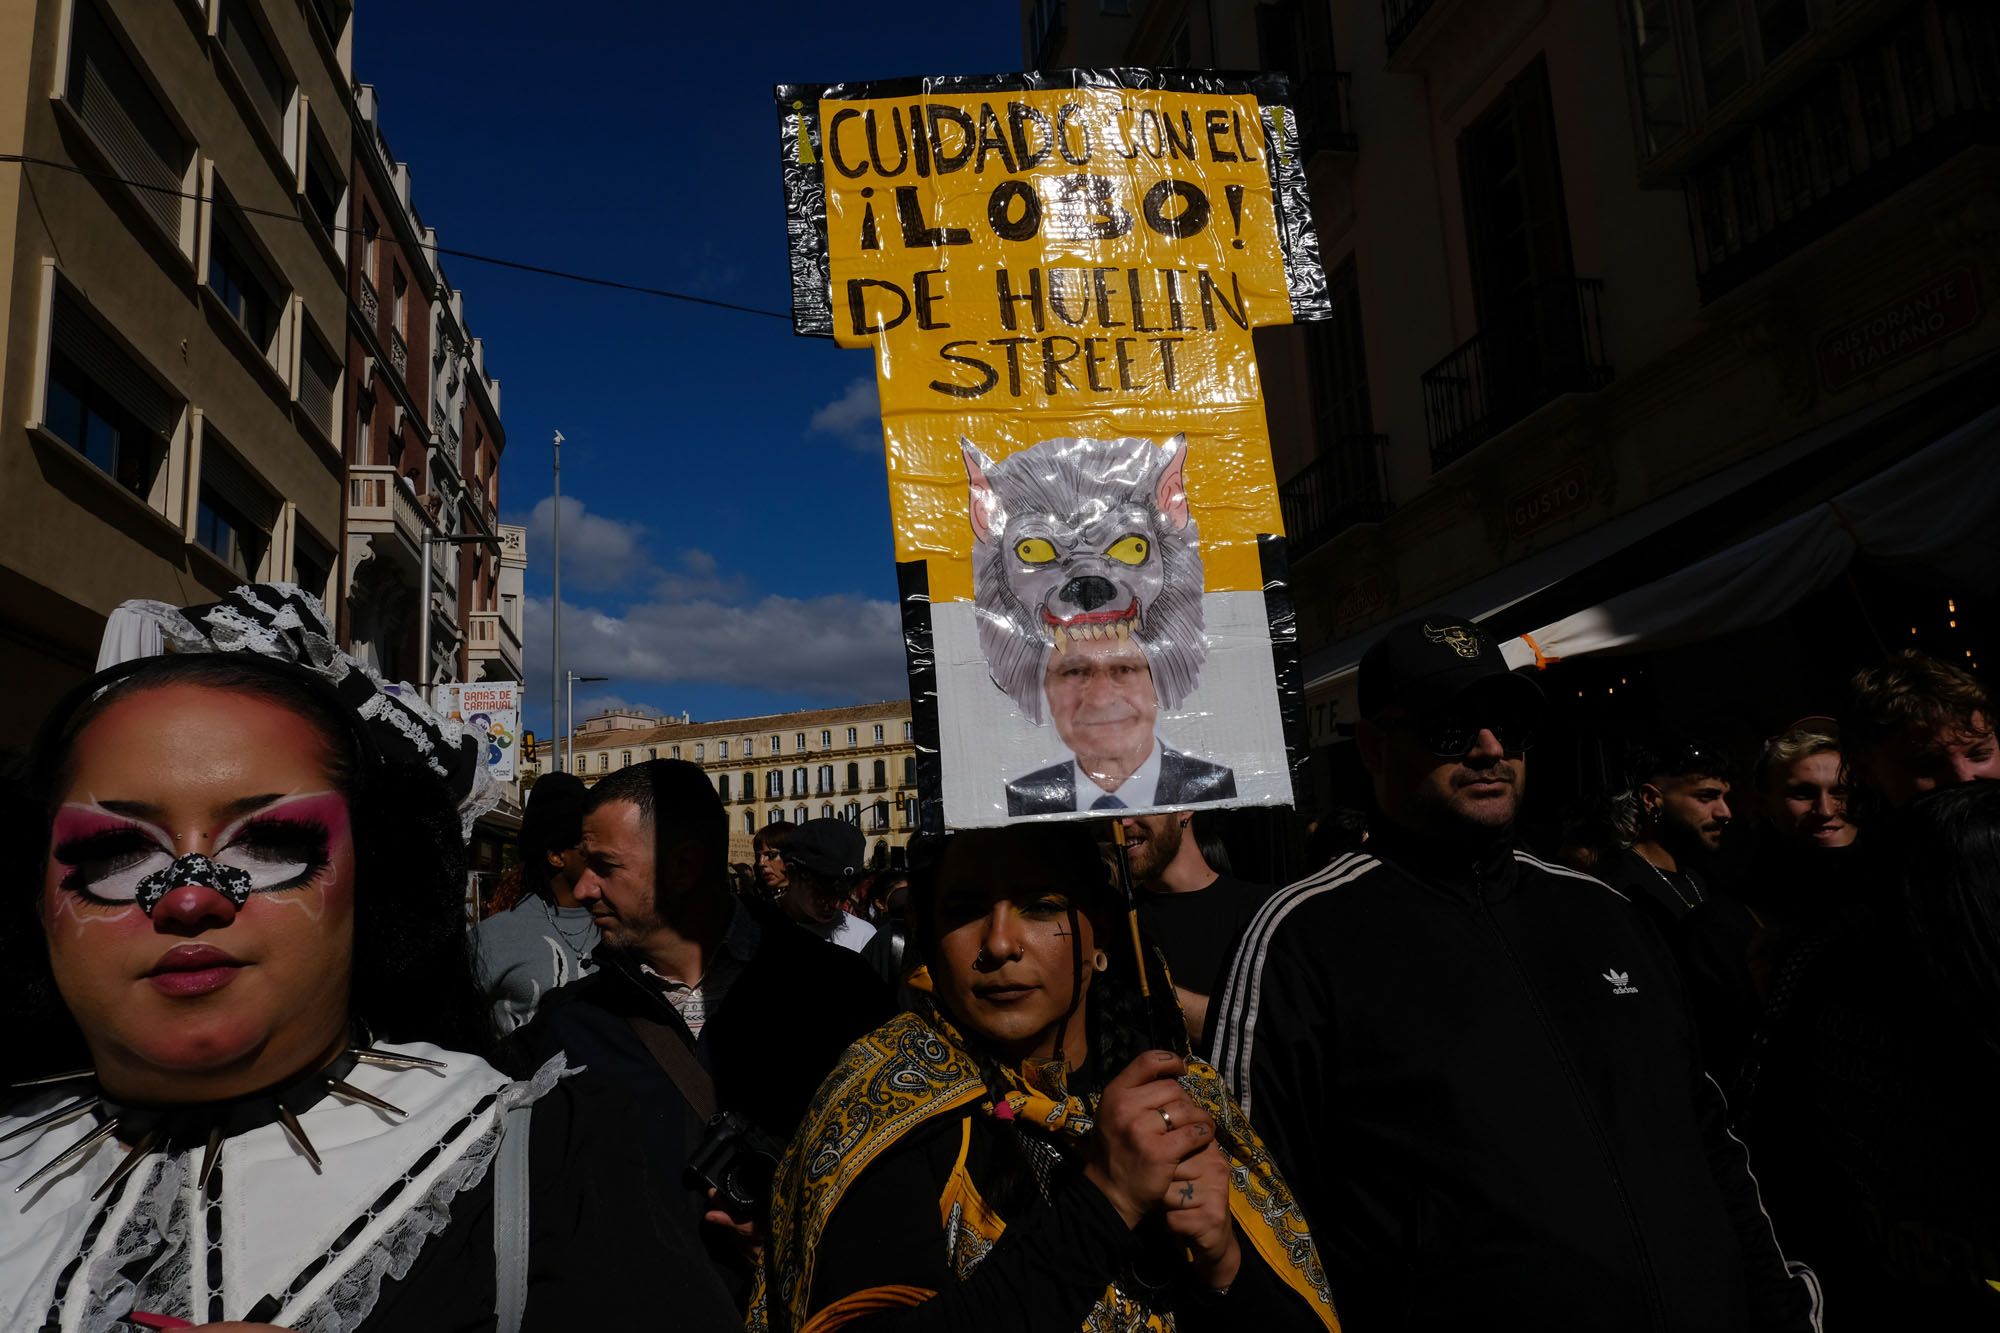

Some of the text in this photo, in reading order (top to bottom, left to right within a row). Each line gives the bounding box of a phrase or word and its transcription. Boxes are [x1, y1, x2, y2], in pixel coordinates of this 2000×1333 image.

[829, 101, 1092, 180] CUIDADO
[1111, 105, 1197, 161] CON
[1205, 108, 1257, 163] EL
[847, 266, 1250, 336] DE HUELIN
[1831, 280, 1957, 357] RISTORANTE
[929, 335, 1184, 398] STREET
[1850, 312, 1945, 371] ITALIANO
[1515, 480, 1579, 526] GUSTO
[464, 690, 512, 701] GANAS DE
[464, 700, 513, 711] CARNAVAL
